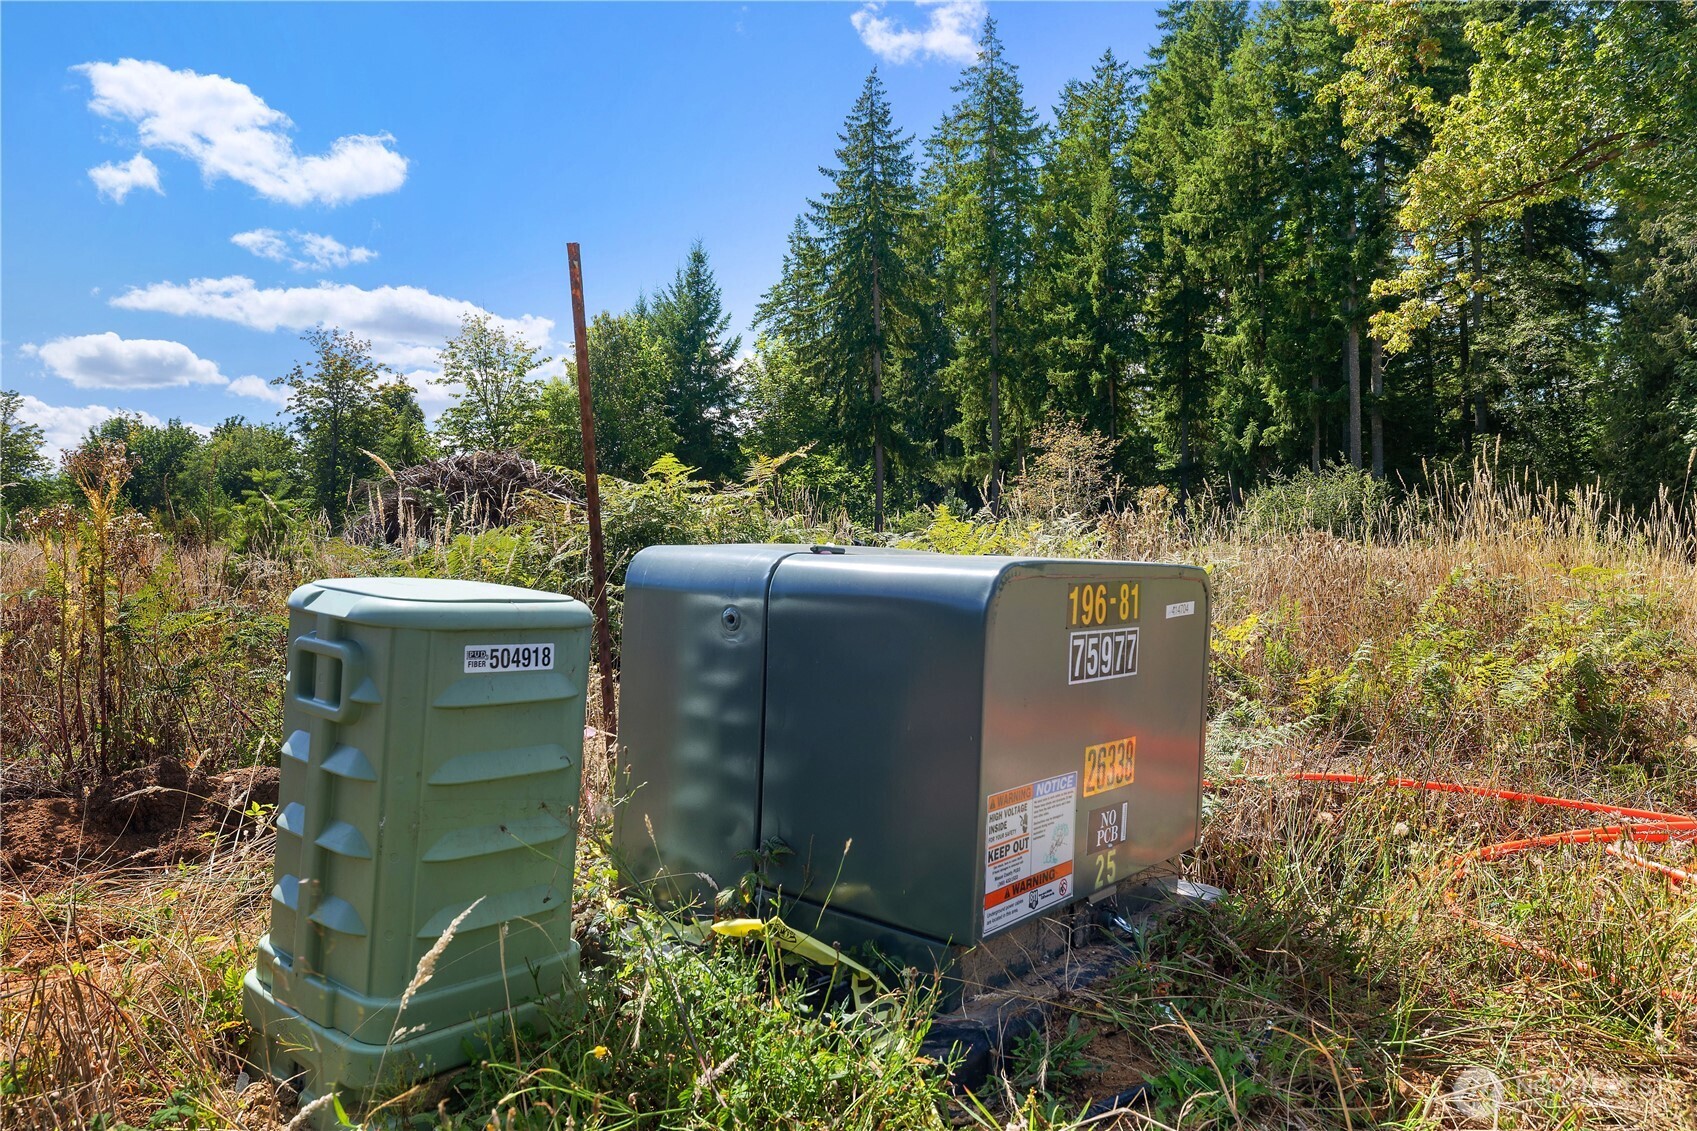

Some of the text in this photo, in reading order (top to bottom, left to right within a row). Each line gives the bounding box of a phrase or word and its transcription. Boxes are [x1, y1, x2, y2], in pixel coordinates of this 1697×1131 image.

[1069, 583, 1139, 625] 196-81
[467, 660, 487, 668] FIBER
[489, 647, 551, 669] 504918
[1073, 634, 1137, 677] 75977
[997, 787, 1031, 805] WARNING
[1035, 774, 1074, 796] NOTICE
[989, 812, 1003, 823] HIGH
[1004, 803, 1028, 818] VOLTAGE
[1100, 809, 1117, 829] NO
[988, 820, 1008, 835] INSIDE
[988, 829, 1017, 843] FOR YOUR SAFETY
[1096, 825, 1119, 847] PCB
[988, 843, 1010, 863] KEEP
[1012, 837, 1030, 853] OUT
[1094, 848, 1117, 890] 25
[1012, 868, 1056, 895] WARNING
